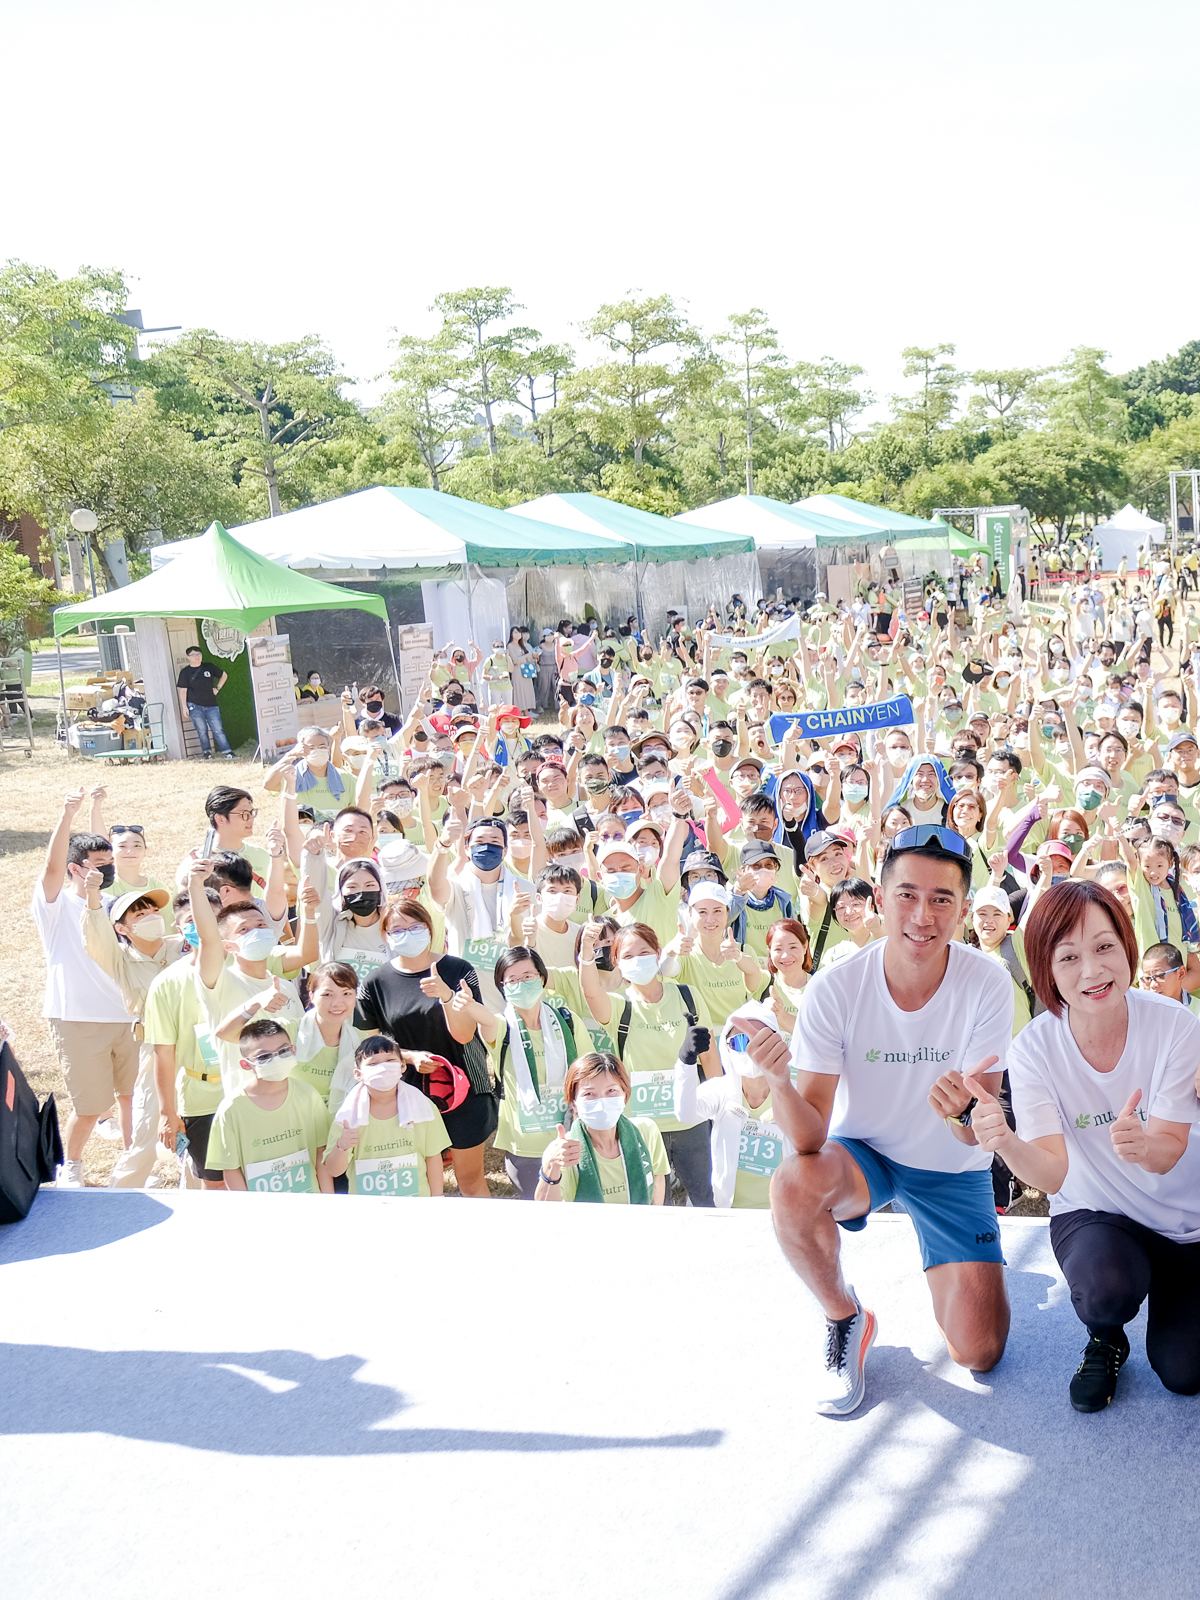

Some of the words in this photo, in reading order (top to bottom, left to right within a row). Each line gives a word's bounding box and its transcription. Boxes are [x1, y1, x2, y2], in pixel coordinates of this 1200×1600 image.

[806, 703, 900, 729] CHAINYEN
[884, 1047, 951, 1064] nutrilite
[255, 1166, 308, 1192] 0614
[362, 1170, 413, 1192] 0613
